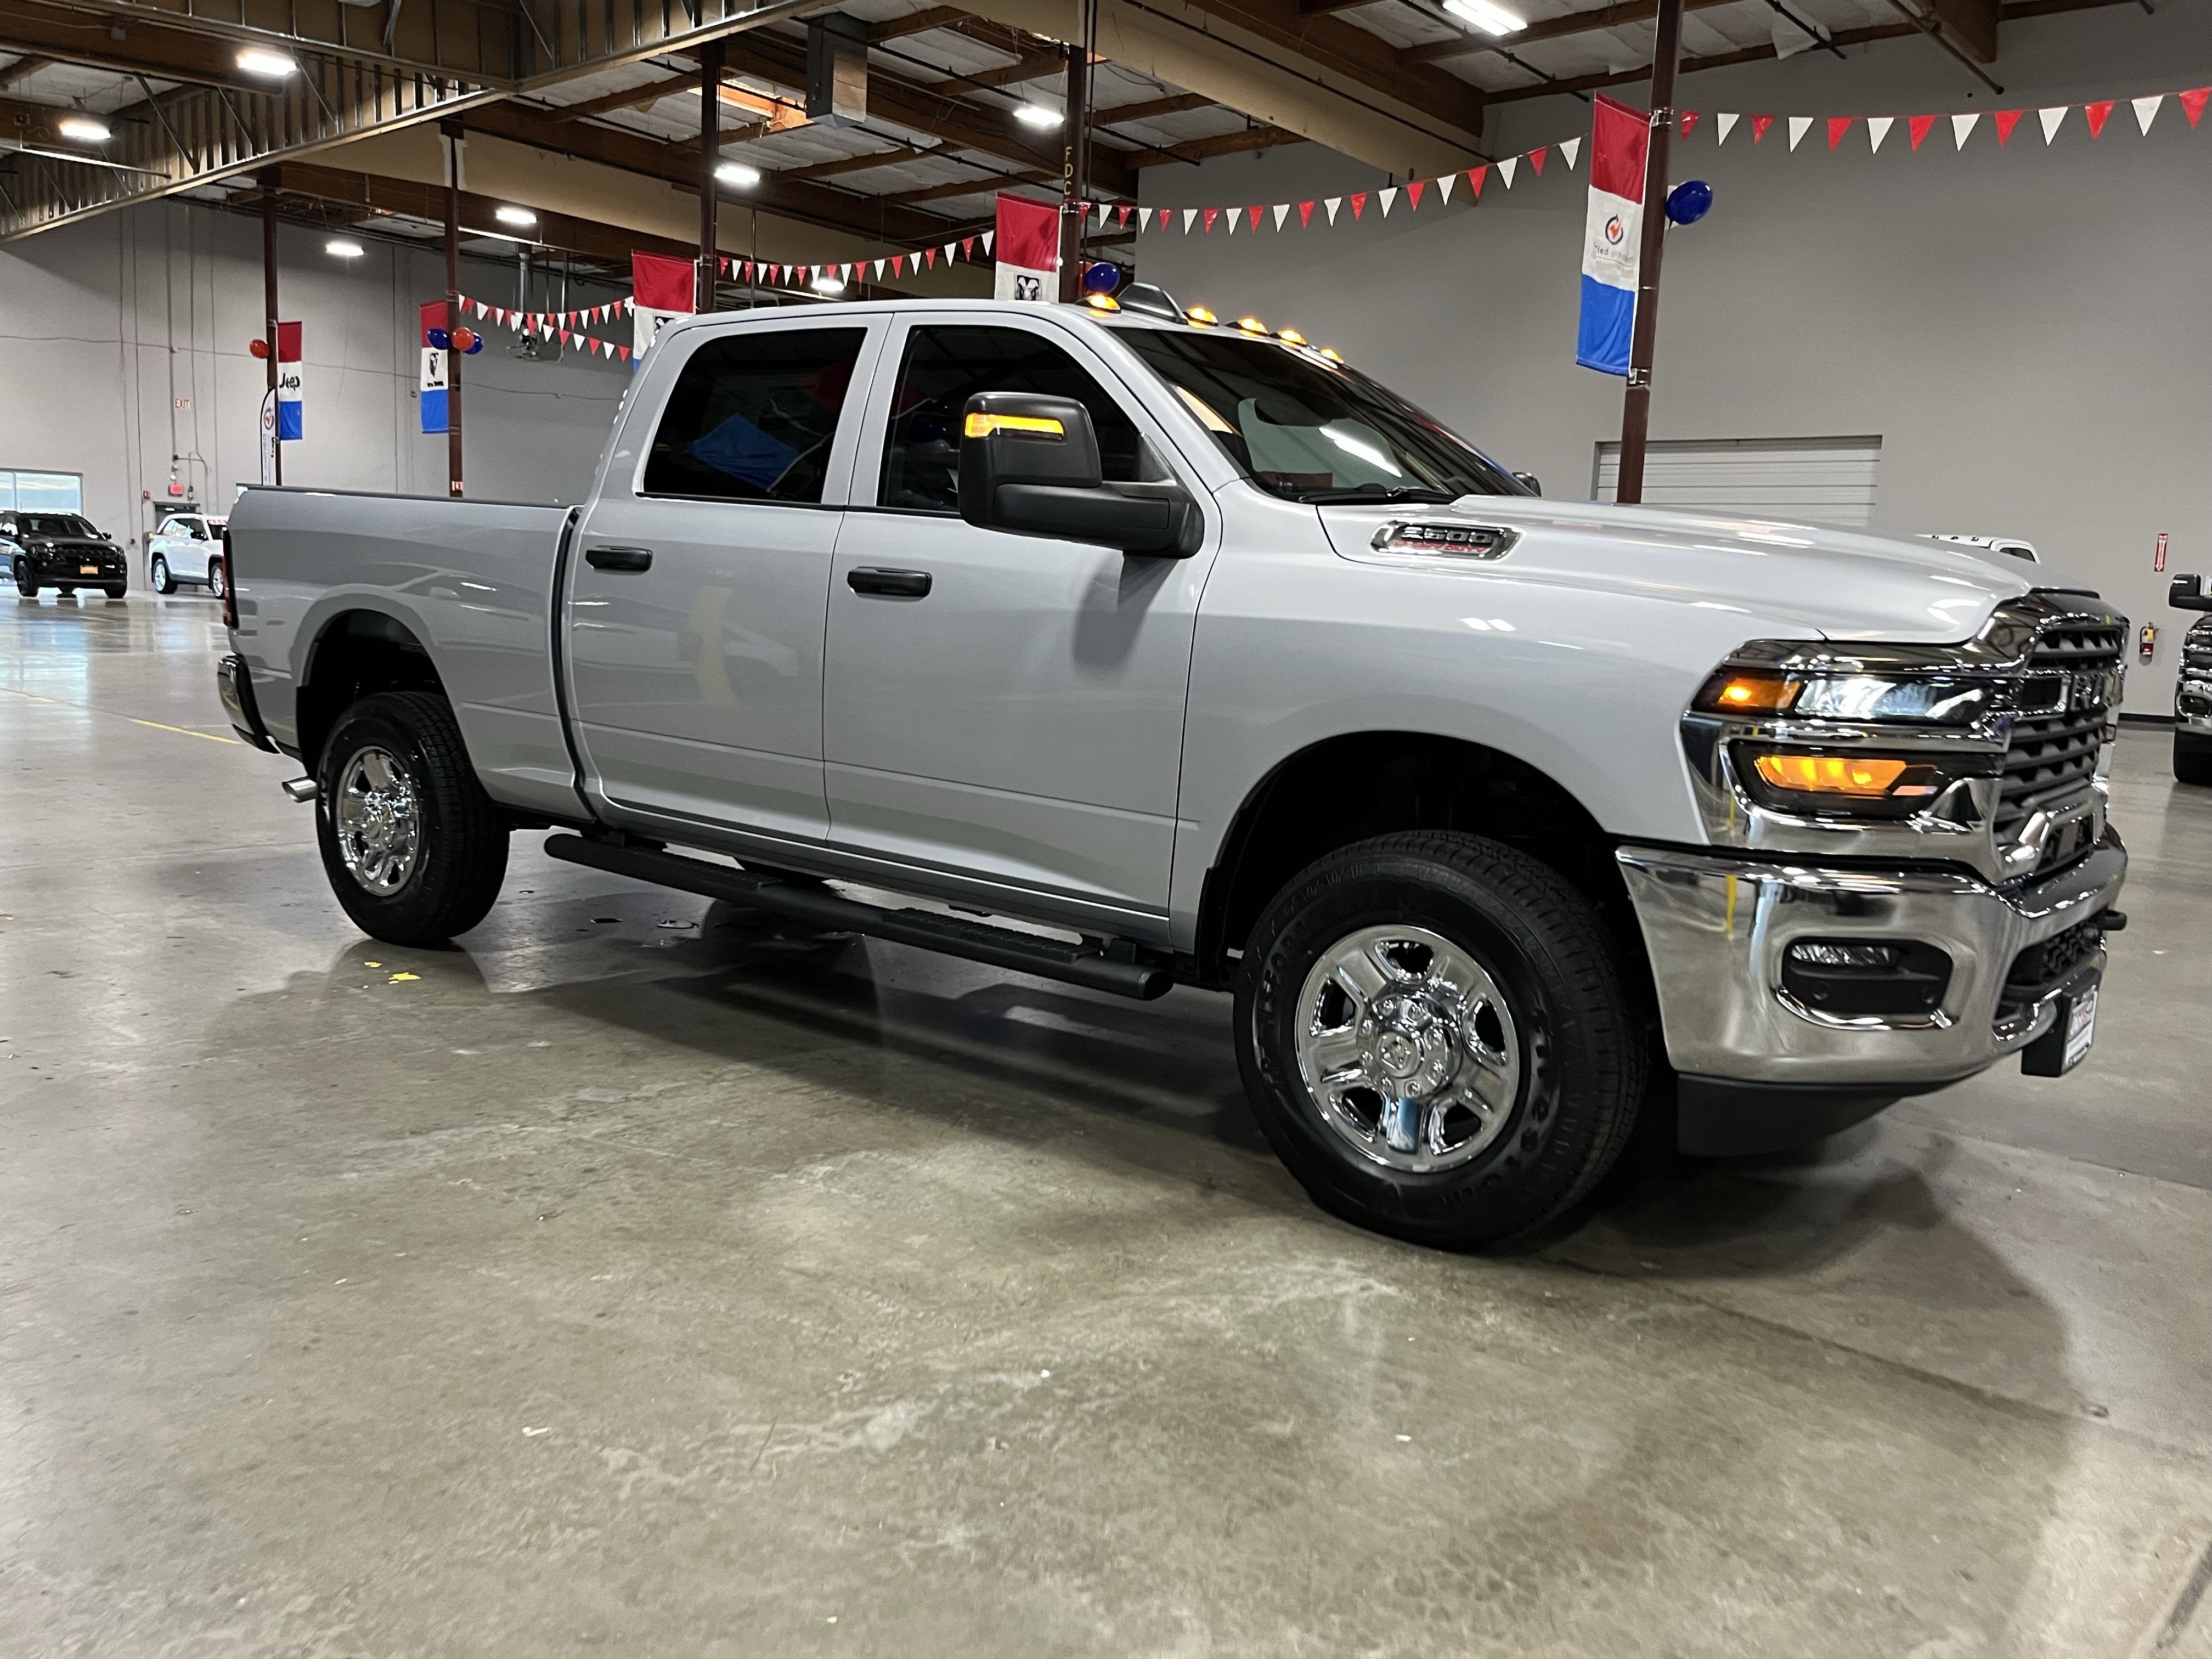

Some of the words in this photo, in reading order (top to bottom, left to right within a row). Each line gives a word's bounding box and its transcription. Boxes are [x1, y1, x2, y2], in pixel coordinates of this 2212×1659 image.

[1064, 146, 1073, 195] FDC
[175, 398, 190, 409] EXIT
[1401, 526, 1493, 544] 2500
